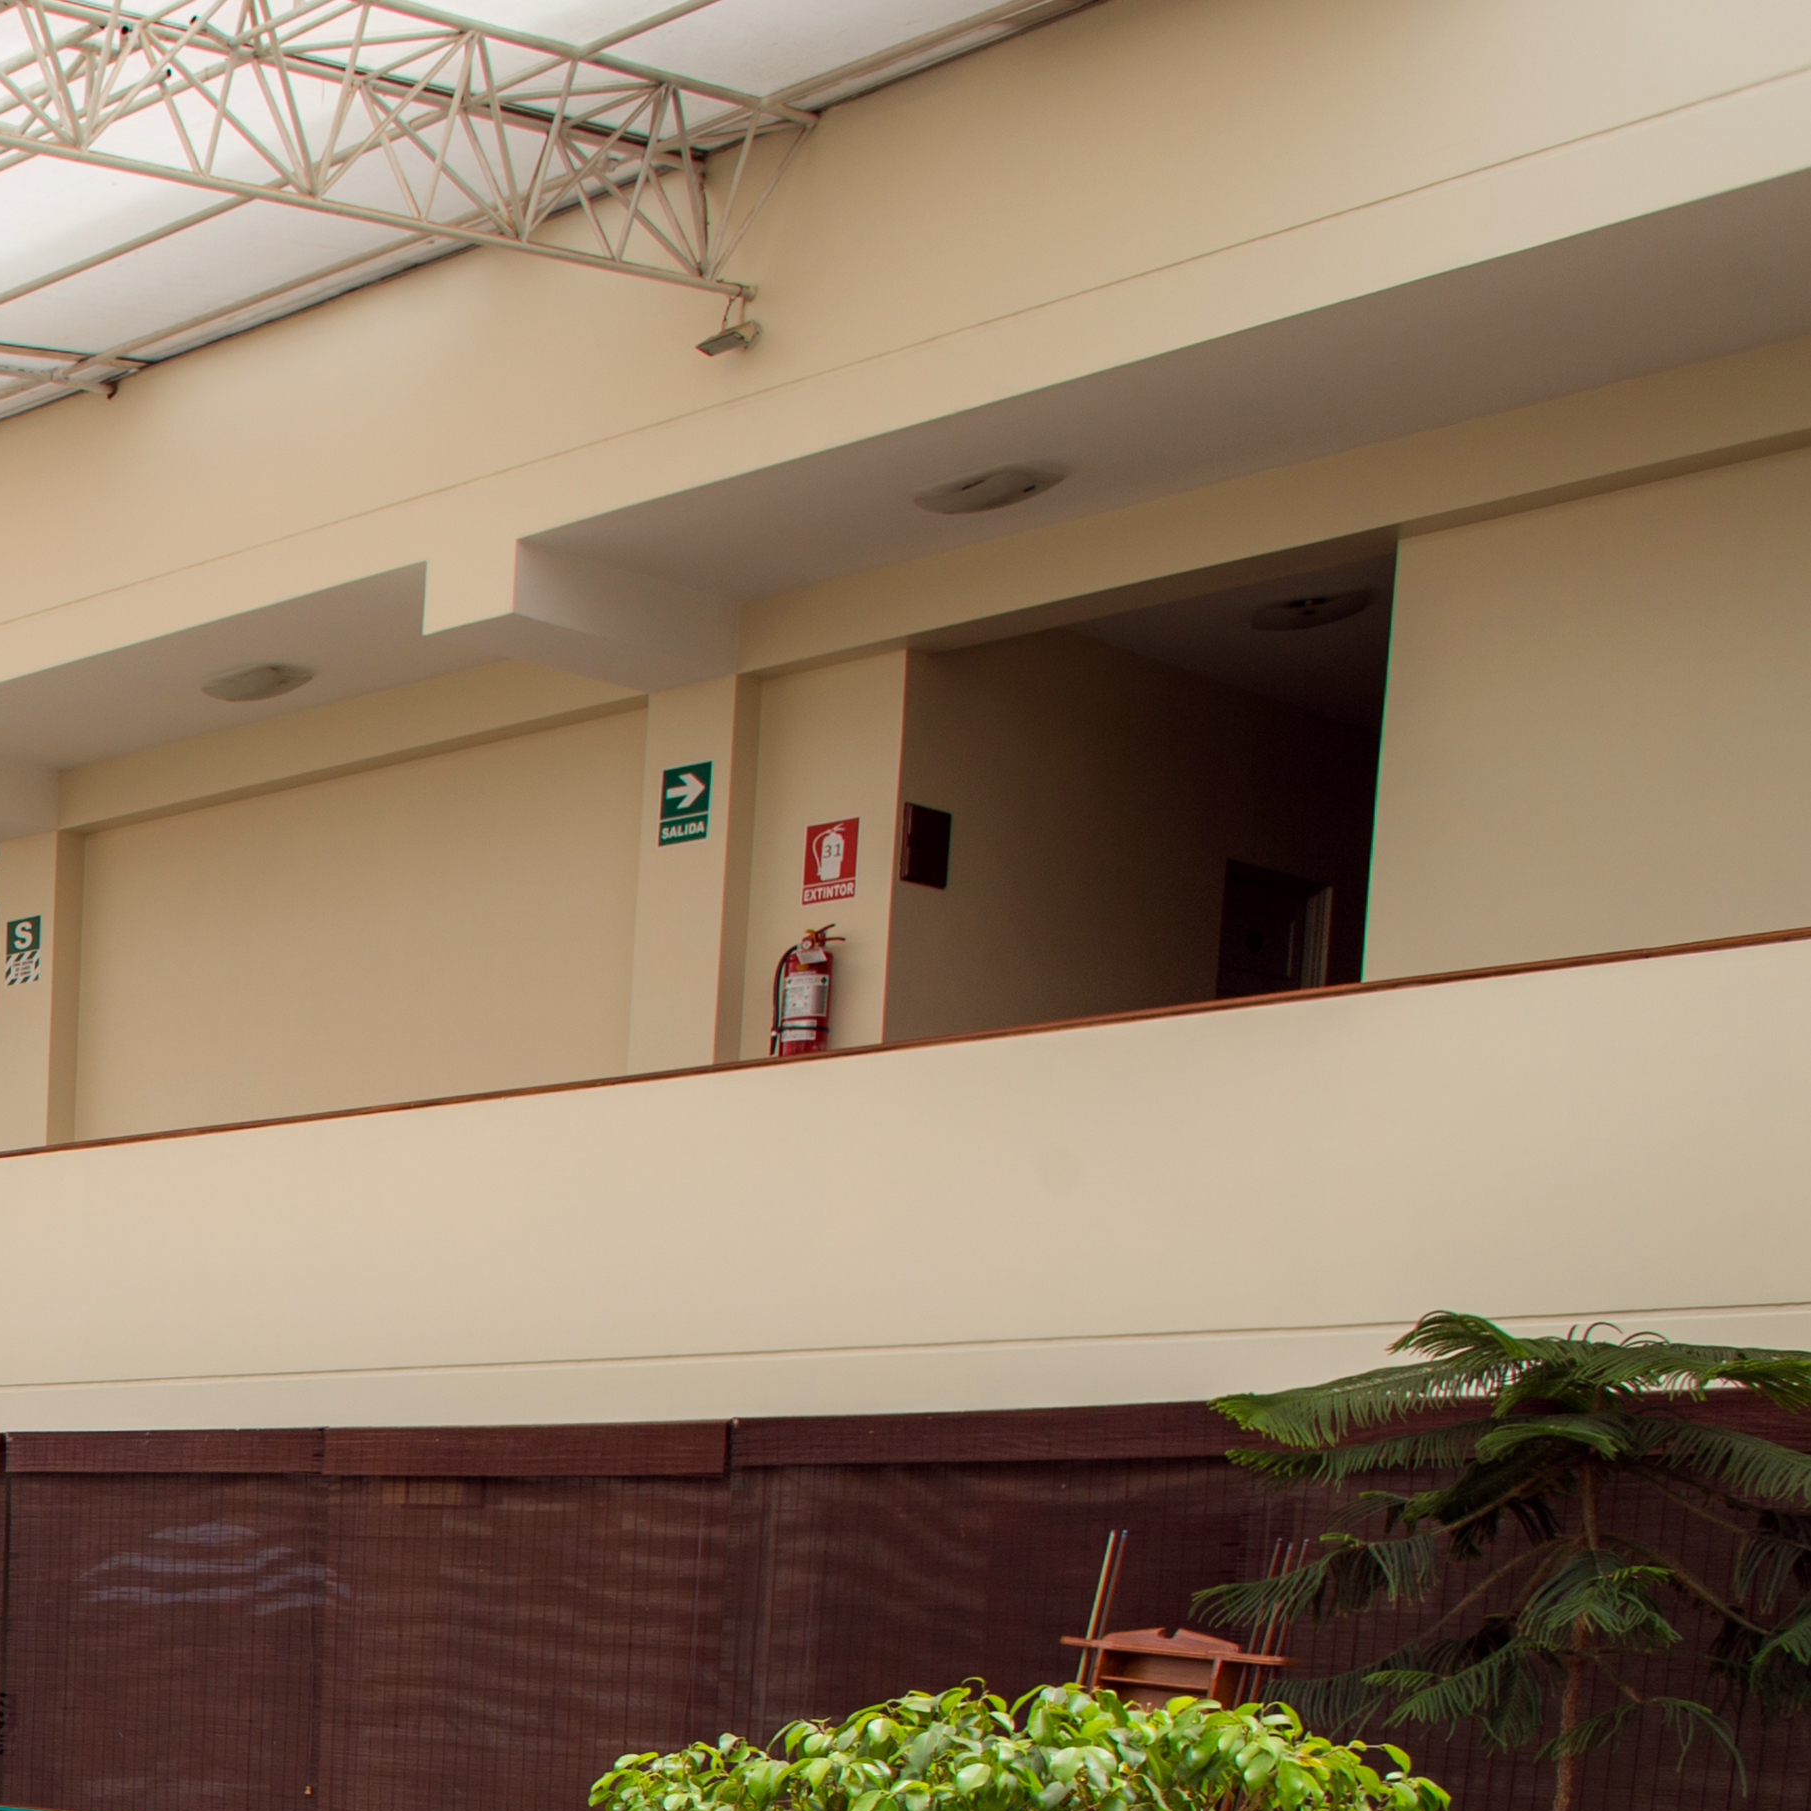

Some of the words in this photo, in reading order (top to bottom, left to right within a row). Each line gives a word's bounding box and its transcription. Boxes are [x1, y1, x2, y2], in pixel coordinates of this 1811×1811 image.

[661, 820, 706, 840] SALIDA
[823, 842, 842, 859] 31
[803, 881, 854, 902] EXTINTOR
[13, 920, 33, 951] S
